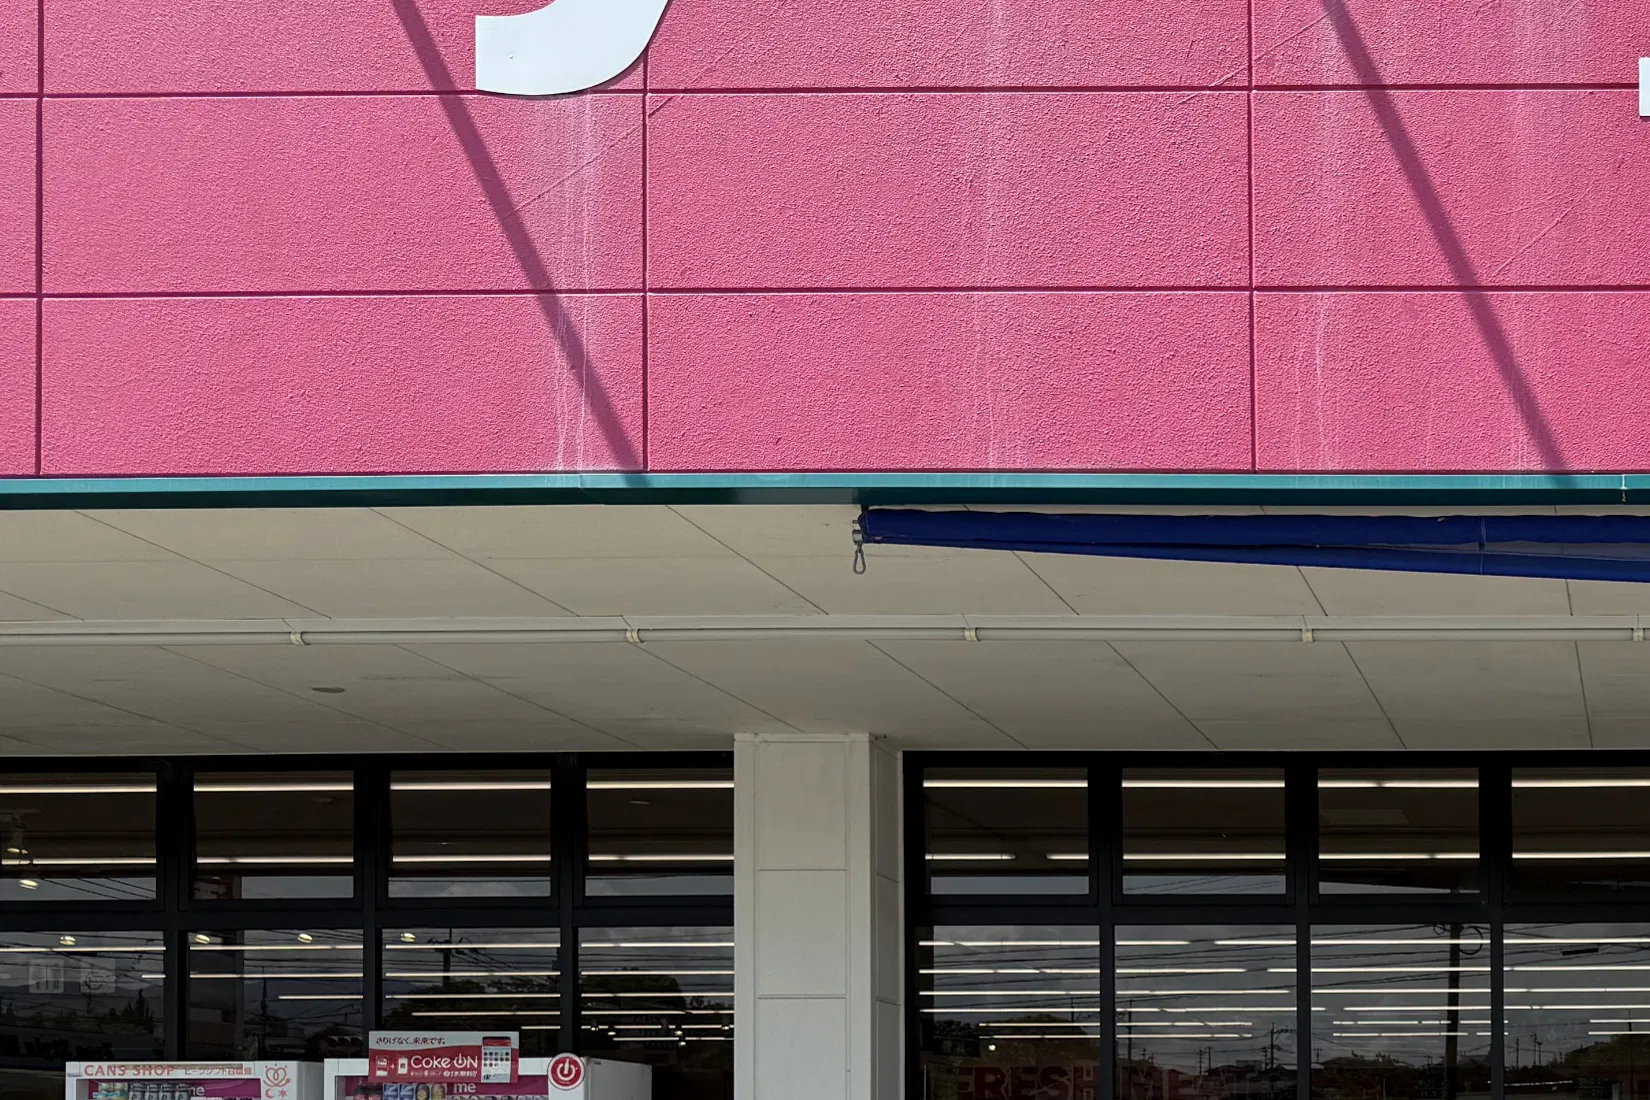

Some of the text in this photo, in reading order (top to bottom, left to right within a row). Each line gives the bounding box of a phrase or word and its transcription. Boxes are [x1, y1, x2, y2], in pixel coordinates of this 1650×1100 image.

[410, 1053, 478, 1069] Coke ON
[84, 1064, 176, 1076] CANS SHOP
